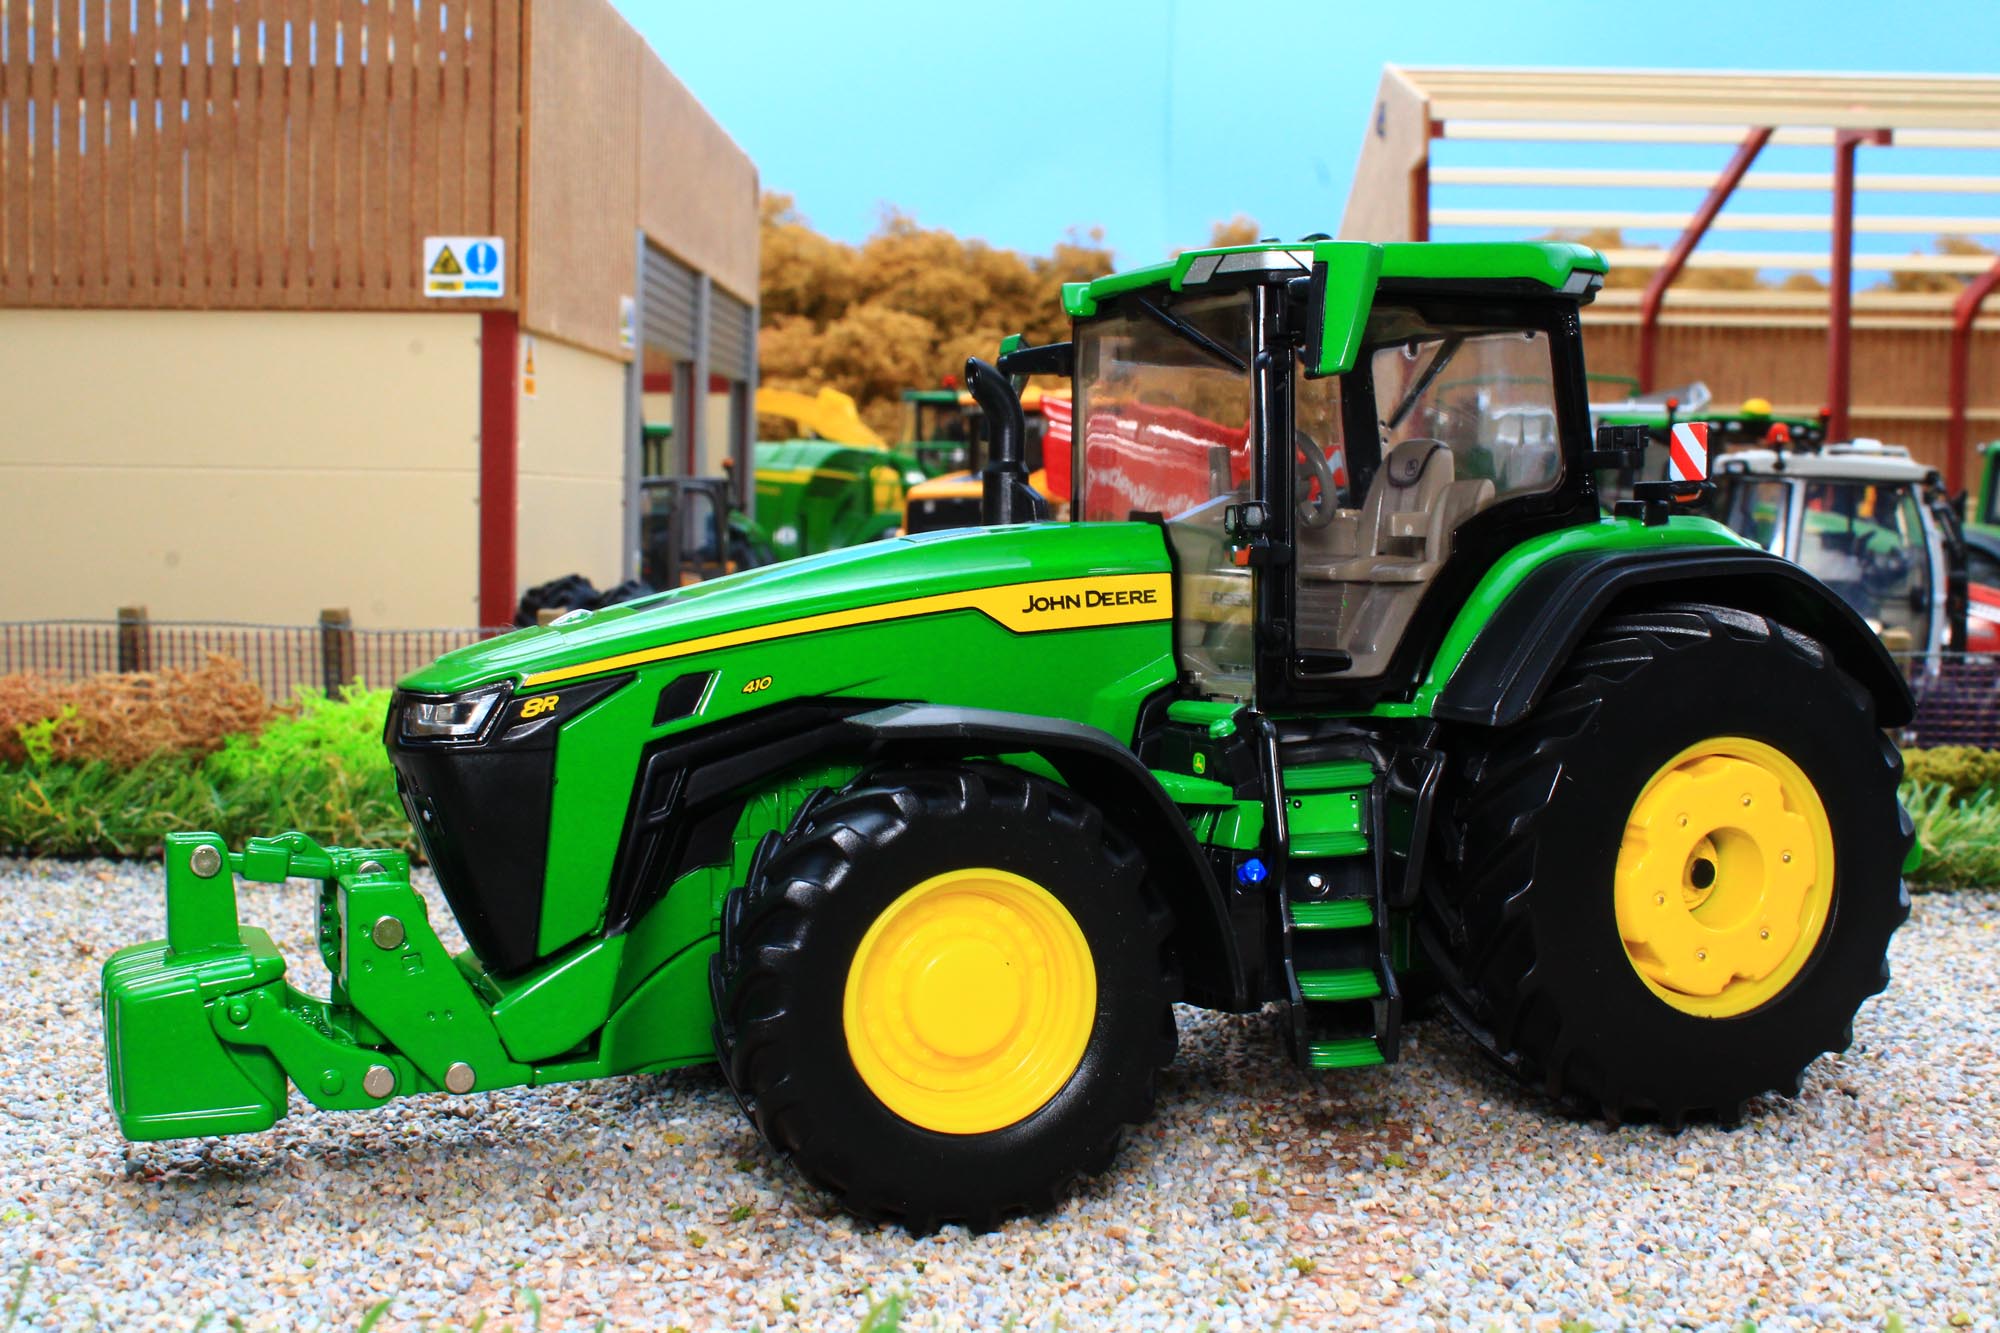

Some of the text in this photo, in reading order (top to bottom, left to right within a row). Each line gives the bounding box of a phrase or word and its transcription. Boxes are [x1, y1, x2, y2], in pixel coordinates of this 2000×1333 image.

[1022, 589, 1157, 613] JOHN DEERE
[742, 676, 773, 694] 410
[520, 695, 560, 718] 8R
